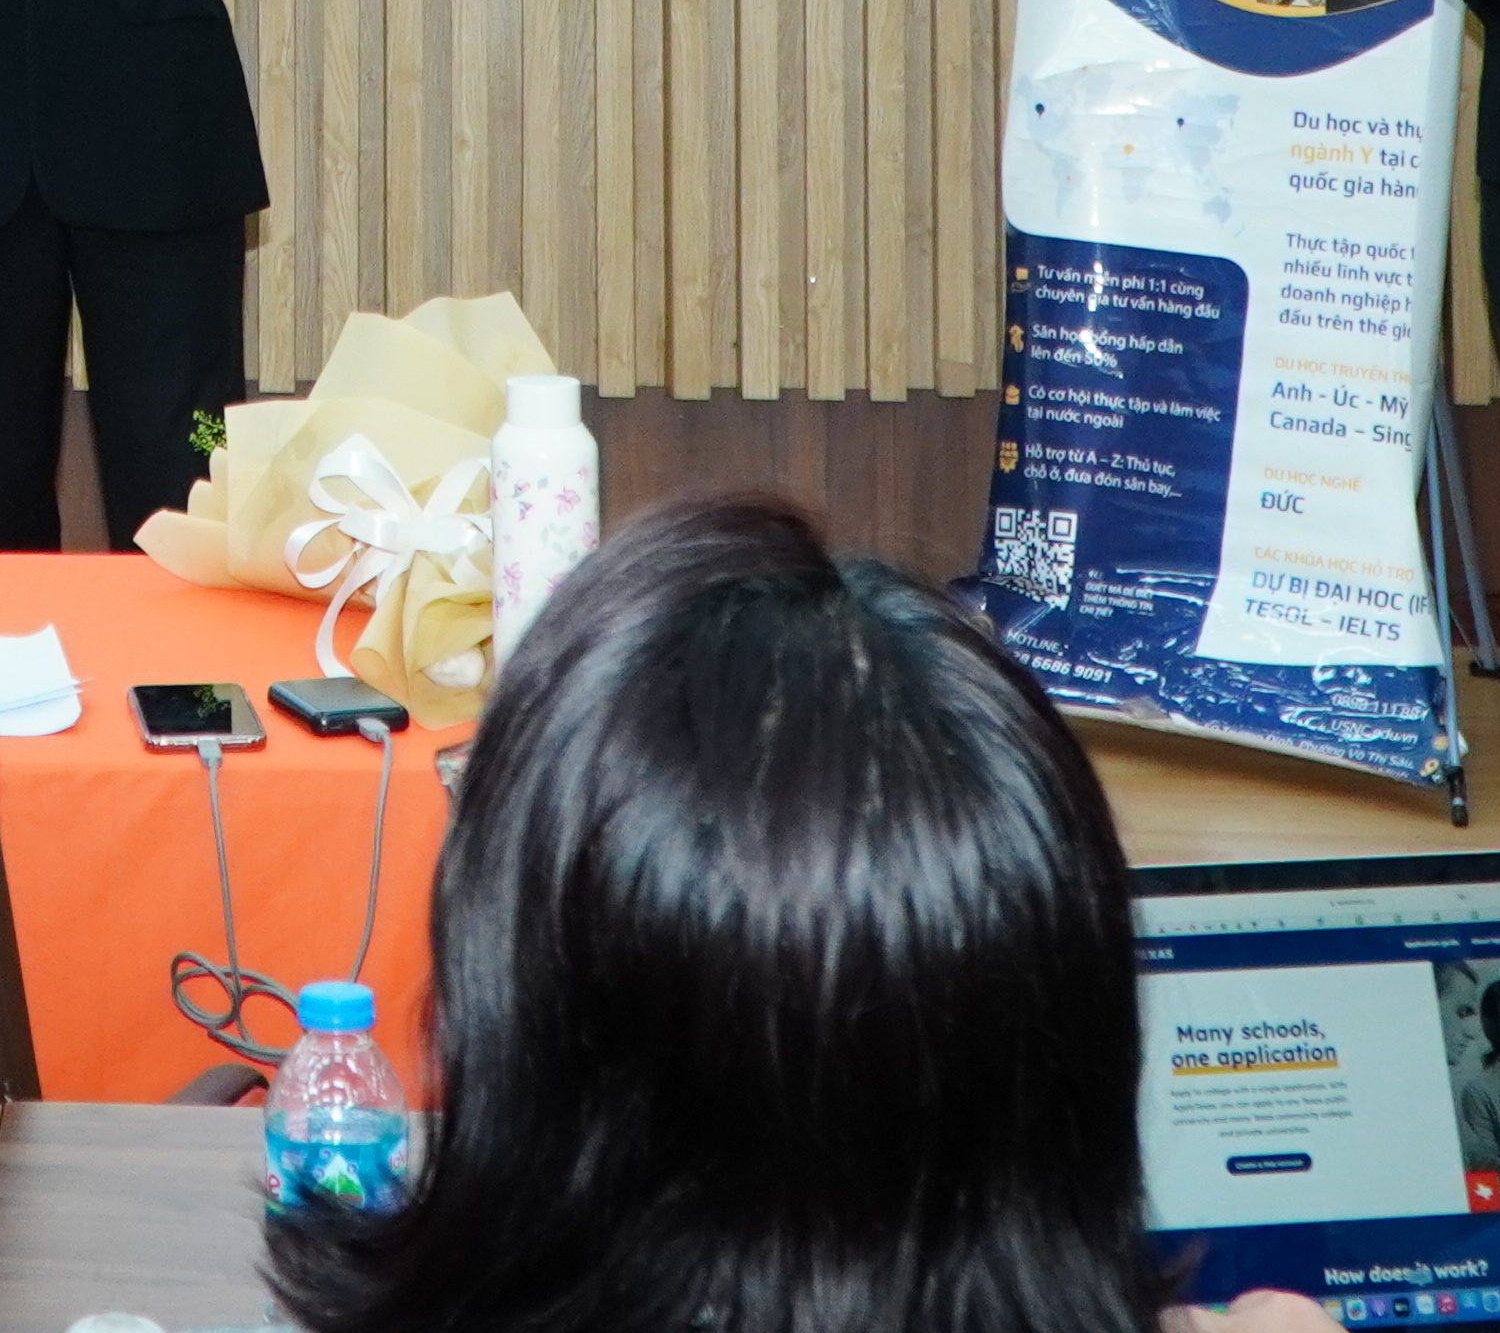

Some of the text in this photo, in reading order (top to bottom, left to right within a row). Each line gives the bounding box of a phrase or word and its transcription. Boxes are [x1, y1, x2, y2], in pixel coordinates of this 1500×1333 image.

[1272, 382, 1312, 403] Anh
[1333, 385, 1359, 409] Úc
[1270, 411, 1347, 437] Canada
[1261, 490, 1305, 515] ĐỨC
[1245, 598, 1400, 642] TESOL IELTS
[1073, 665, 1112, 683] 9091
[1176, 1019, 1326, 1046] Many schools,
[1171, 1041, 1338, 1068] one application
[1324, 1265, 1365, 1286] How
[1433, 1259, 1489, 1281] work?
